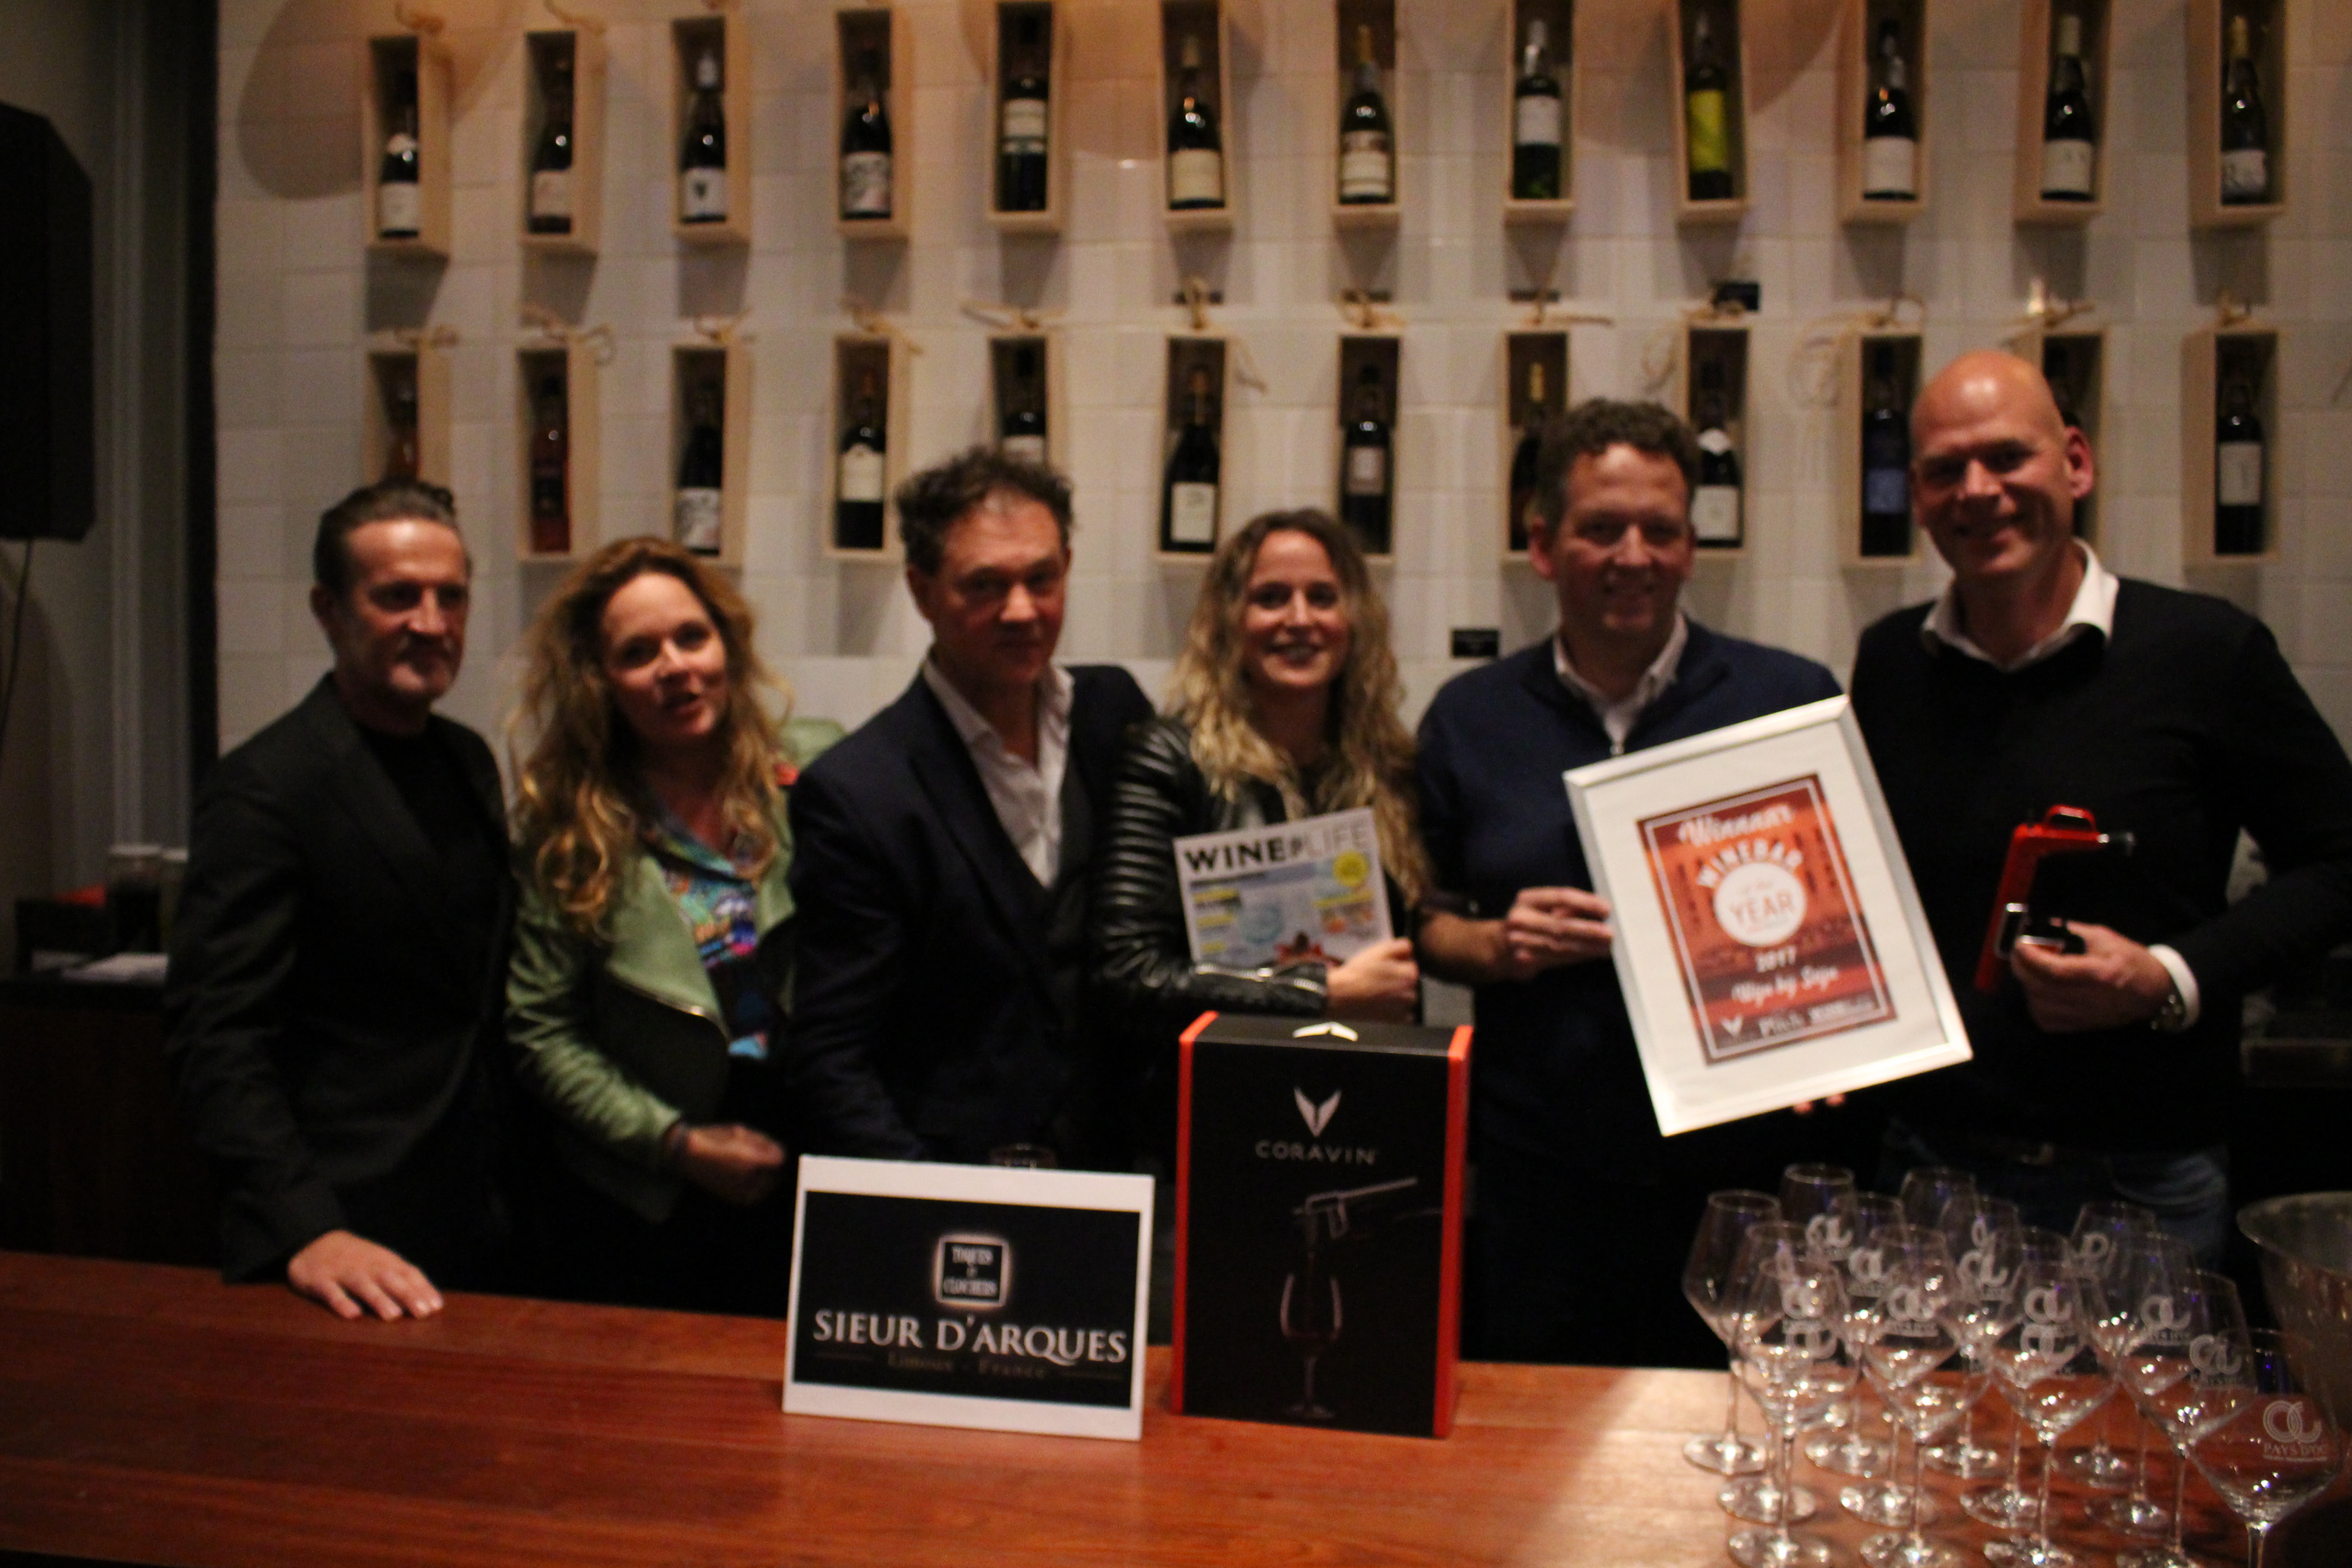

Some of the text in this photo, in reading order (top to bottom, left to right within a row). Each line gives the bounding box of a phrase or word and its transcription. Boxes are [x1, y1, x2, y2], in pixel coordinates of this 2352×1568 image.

[1185, 837, 1286, 872] WINE
[1697, 838, 1804, 887] WINEBAR
[1730, 889, 1794, 927] YEAR
[1754, 948, 1797, 973] 2017
[1254, 1139, 1377, 1166] CORAVIN
[813, 1309, 1127, 1366] SIEUR D'ARQUES
